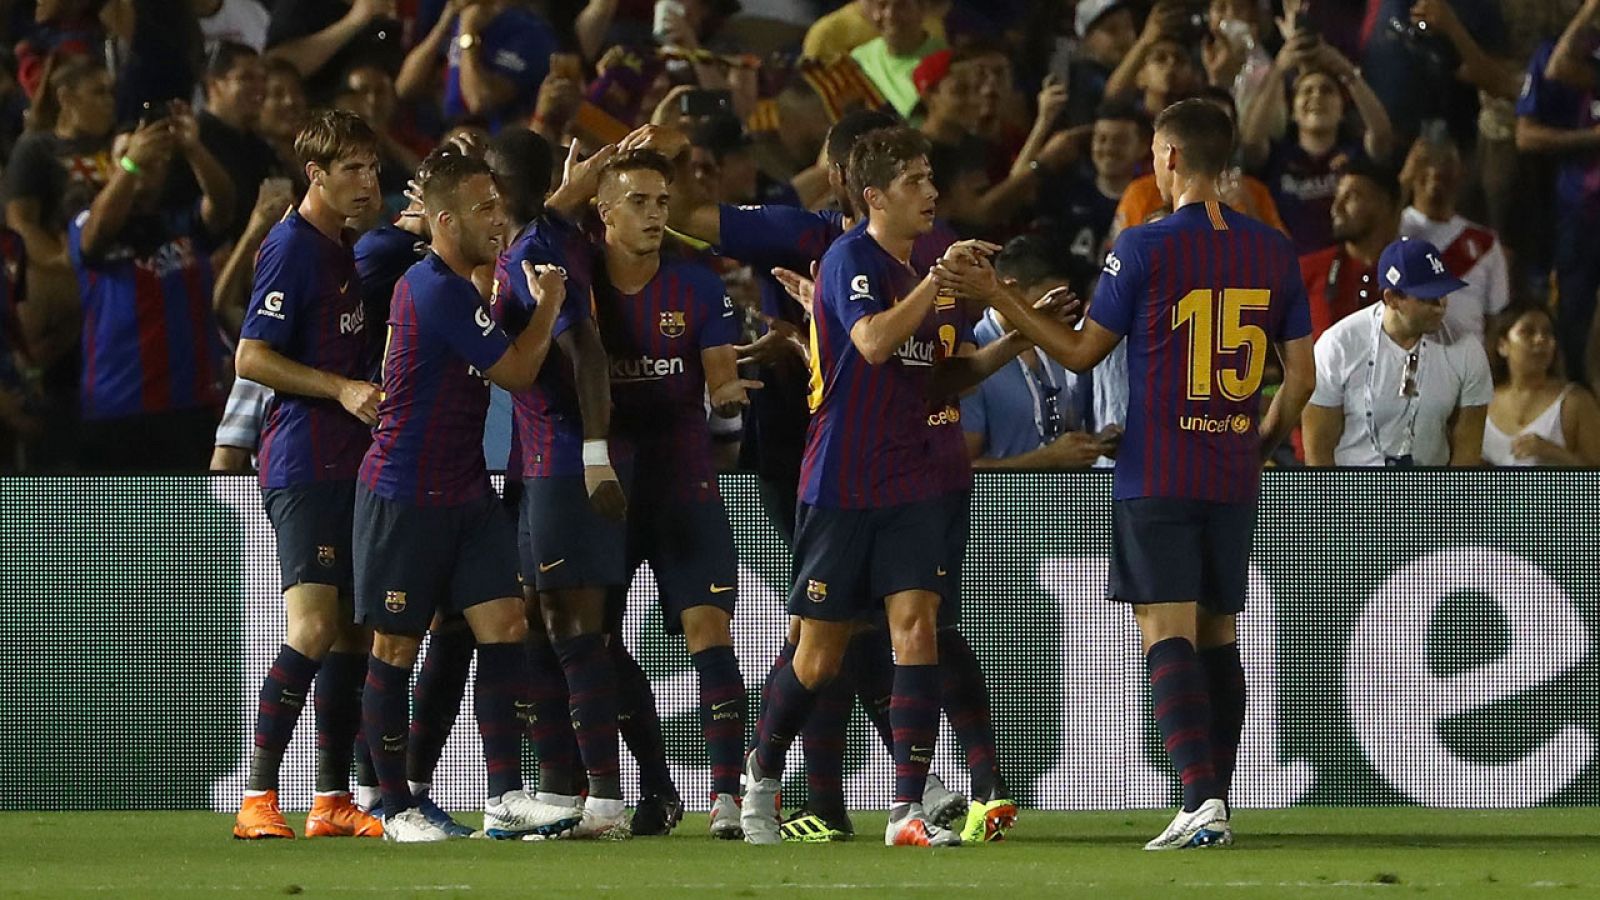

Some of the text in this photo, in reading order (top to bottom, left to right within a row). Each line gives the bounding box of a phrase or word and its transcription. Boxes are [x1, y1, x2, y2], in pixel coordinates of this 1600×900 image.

[1425, 253, 1445, 275] LA
[1171, 288, 1271, 402] 15
[609, 354, 685, 377] kuten
[1179, 414, 1231, 433] unicef
